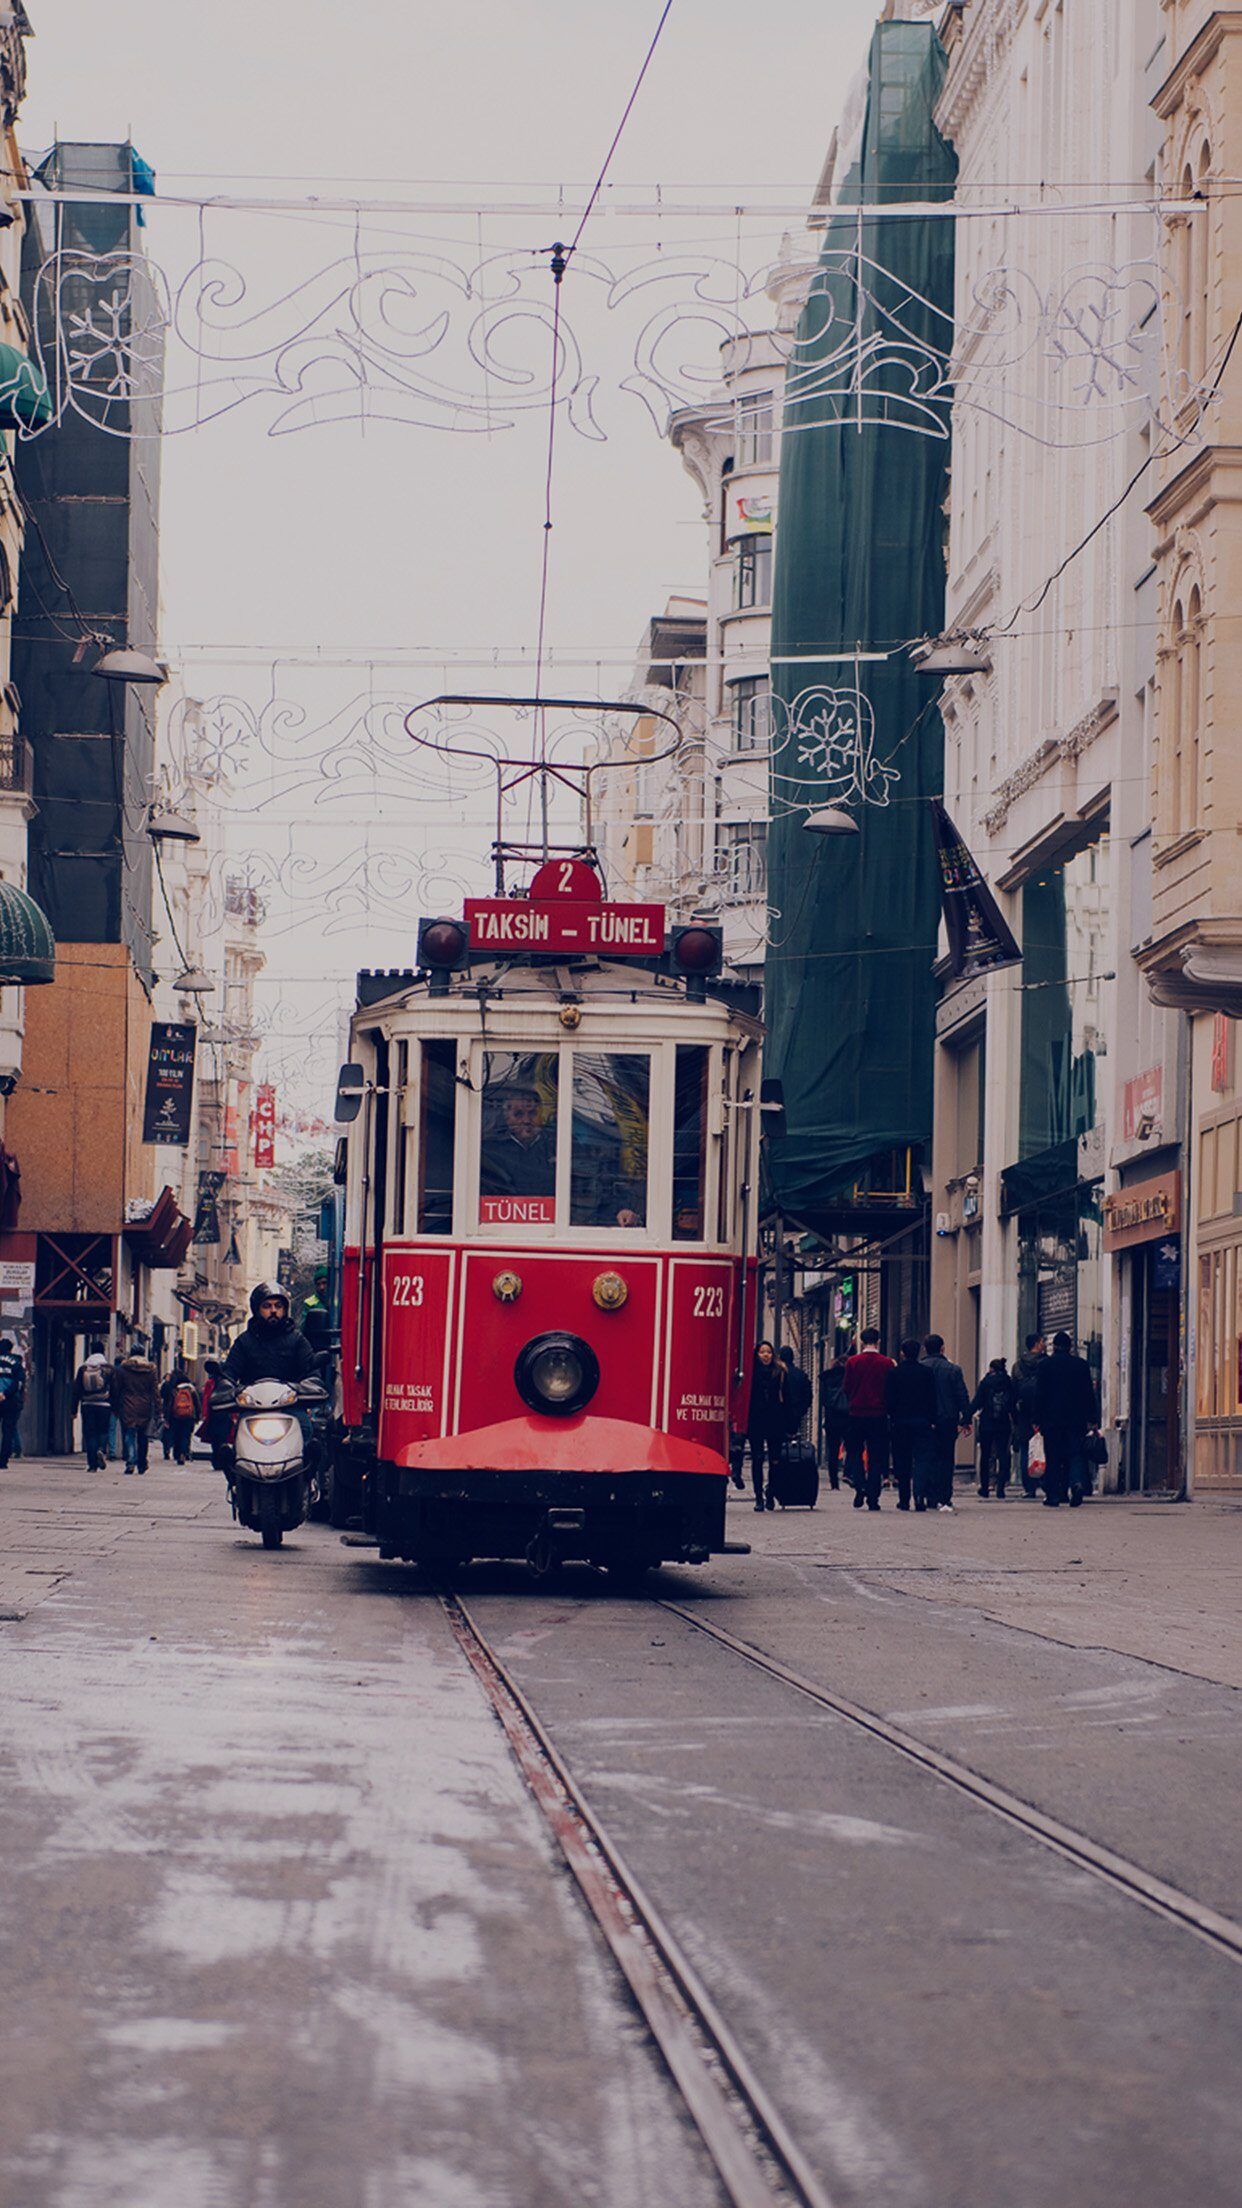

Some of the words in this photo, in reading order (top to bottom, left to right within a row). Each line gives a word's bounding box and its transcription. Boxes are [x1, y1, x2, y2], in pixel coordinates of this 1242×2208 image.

[558, 862, 574, 893] 2
[474, 909, 549, 941] TAKSİM
[587, 912, 657, 944] TÜNEL
[258, 1102, 273, 1153] CHP
[484, 1199, 550, 1221] TÜNEL
[392, 1275, 424, 1306] 223
[693, 1286, 723, 1317] 223
